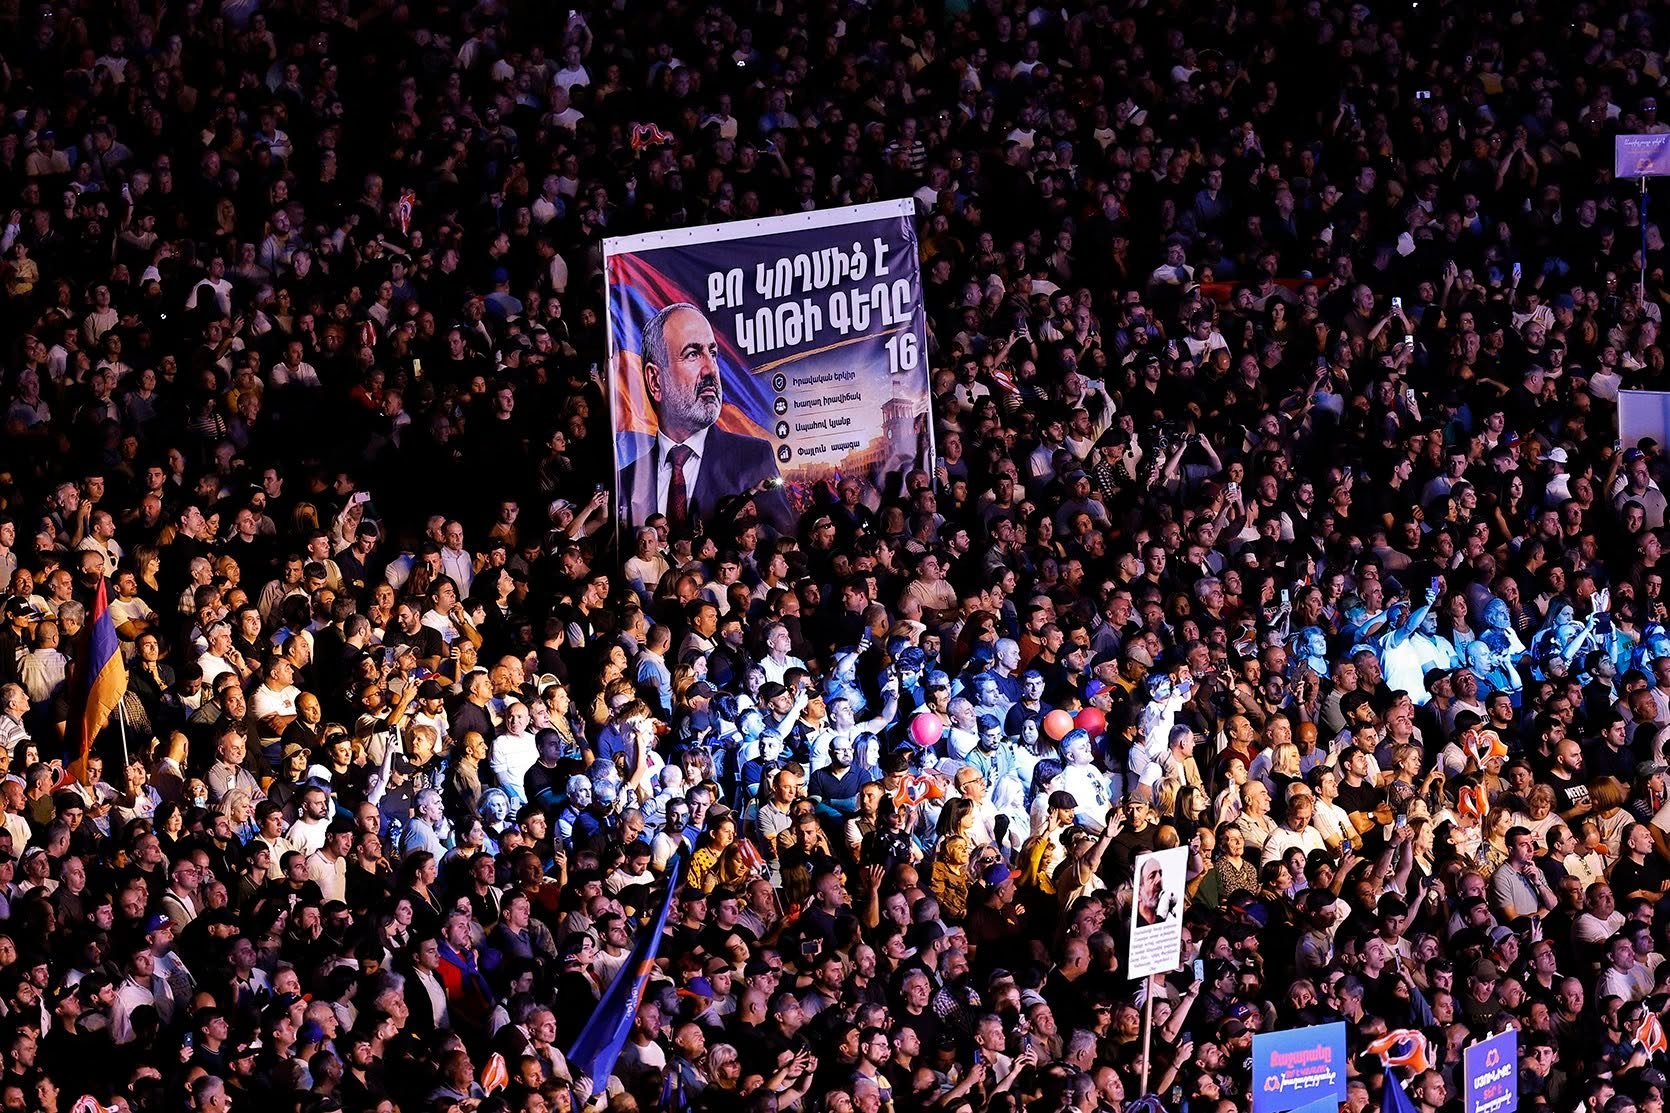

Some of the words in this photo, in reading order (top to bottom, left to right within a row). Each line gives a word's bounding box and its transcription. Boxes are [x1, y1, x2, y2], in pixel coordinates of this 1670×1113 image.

[707, 268, 744, 312] ՔՈ
[755, 241, 868, 300] ԿՈՂՄԻՑ
[873, 237, 889, 277] Է
[735, 298, 823, 355] ԿՈԹԻ
[829, 279, 912, 335] ԳԵՂԸ
[885, 333, 918, 374] 16
[792, 373, 833, 386] Իրավական
[793, 398, 822, 408] Խաղաղ
[795, 419, 827, 432] Ապահով
[828, 416, 851, 428] կյանք
[797, 444, 827, 457] Փայլուն
[830, 440, 860, 451] ապագա
